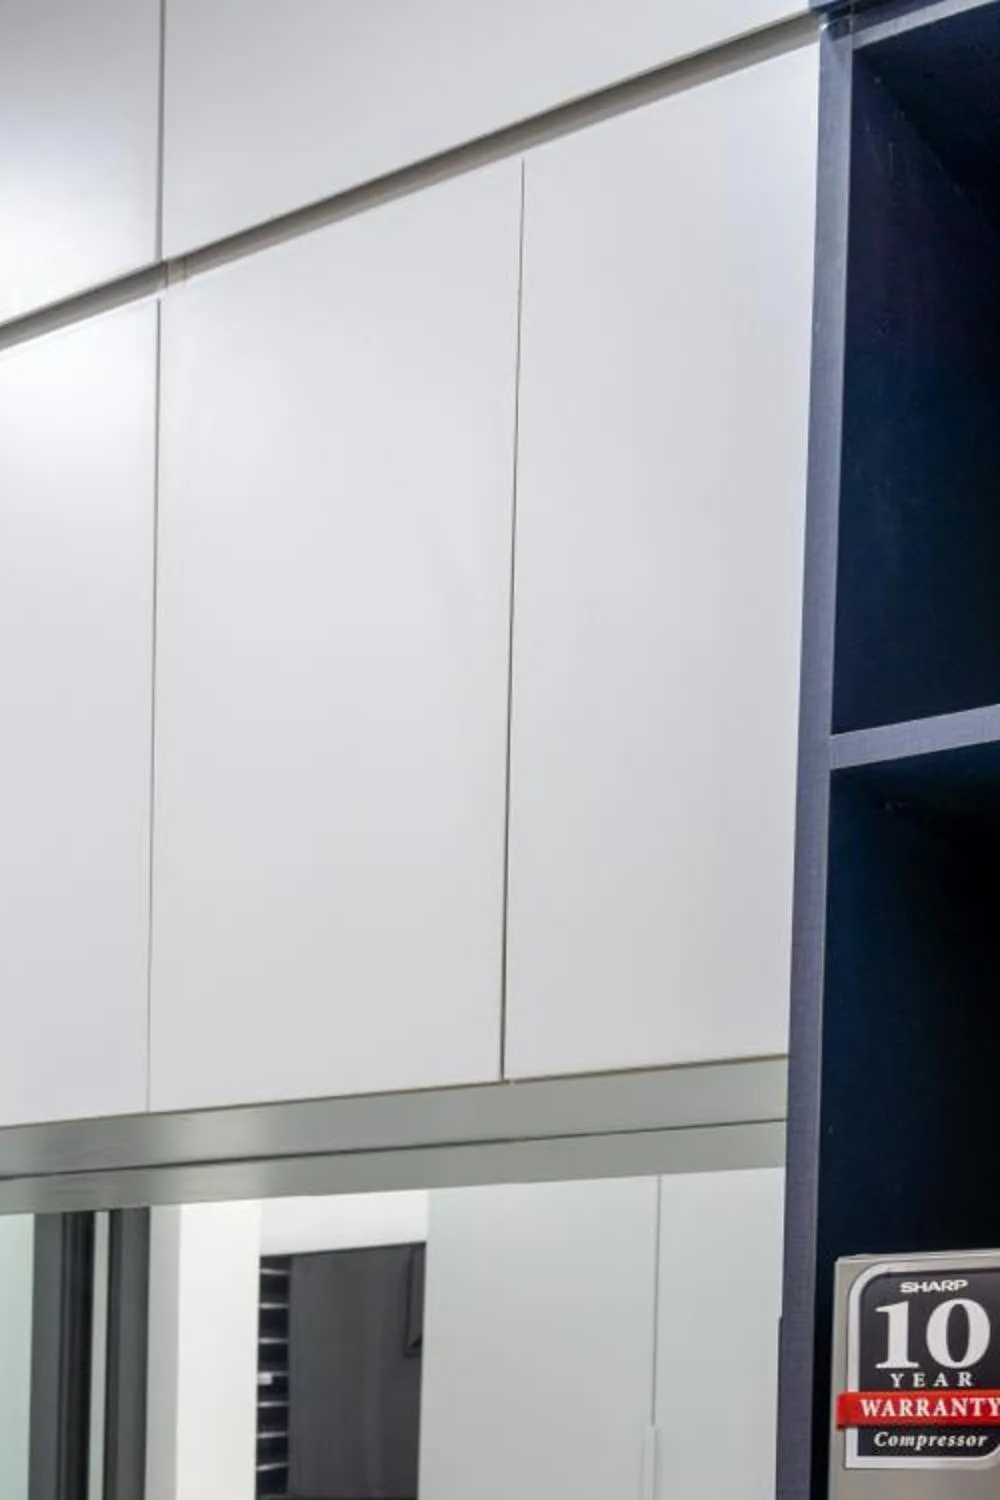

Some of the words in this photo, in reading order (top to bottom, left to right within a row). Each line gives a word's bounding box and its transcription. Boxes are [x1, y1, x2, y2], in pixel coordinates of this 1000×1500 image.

[900, 1279, 969, 1293] SHARP
[875, 1298, 991, 1369] 10
[890, 1372, 973, 1388] YEAR
[859, 1397, 1000, 1418] WARRANTY
[873, 1431, 988, 1450] Compressor
